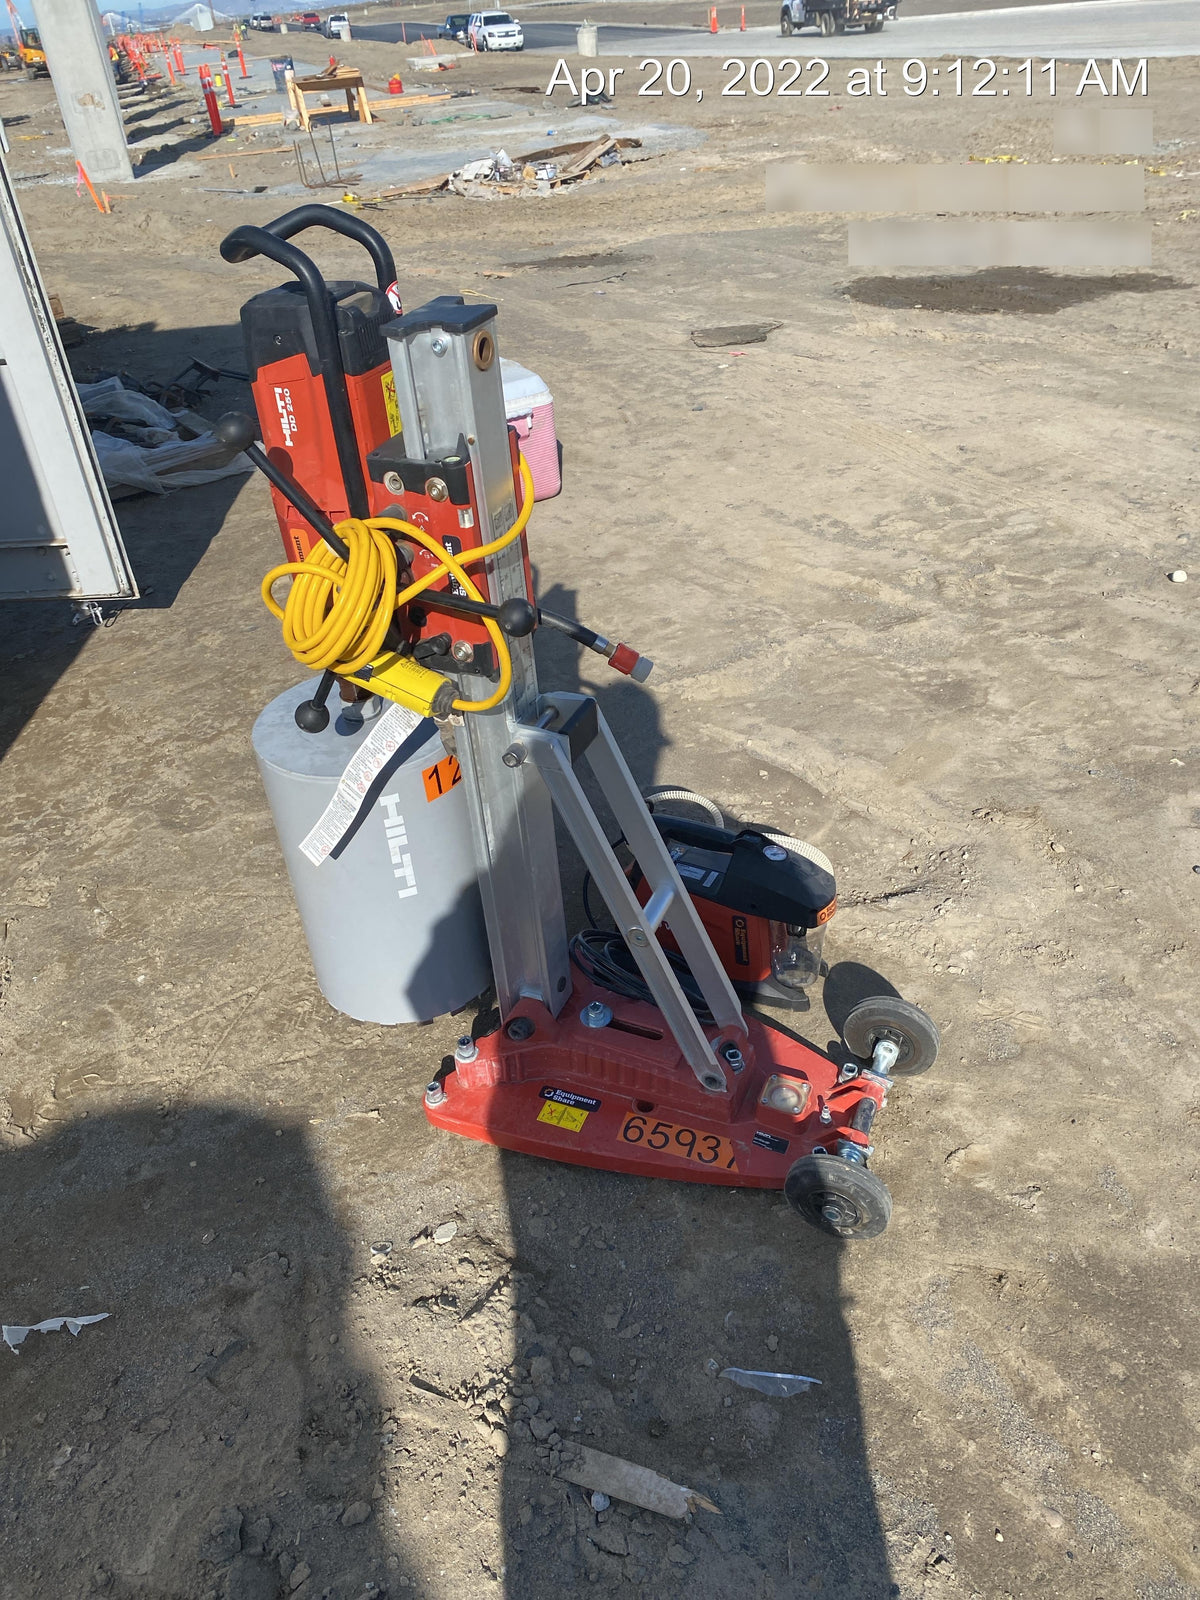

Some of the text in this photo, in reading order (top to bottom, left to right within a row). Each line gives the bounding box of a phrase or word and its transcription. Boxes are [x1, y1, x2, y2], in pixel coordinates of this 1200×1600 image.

[274, 387, 294, 447] HILTI
[288, 414, 298, 432] DD
[380, 793, 418, 899] HILTI
[552, 1095, 575, 1106] Share
[555, 1089, 597, 1106] Equipment
